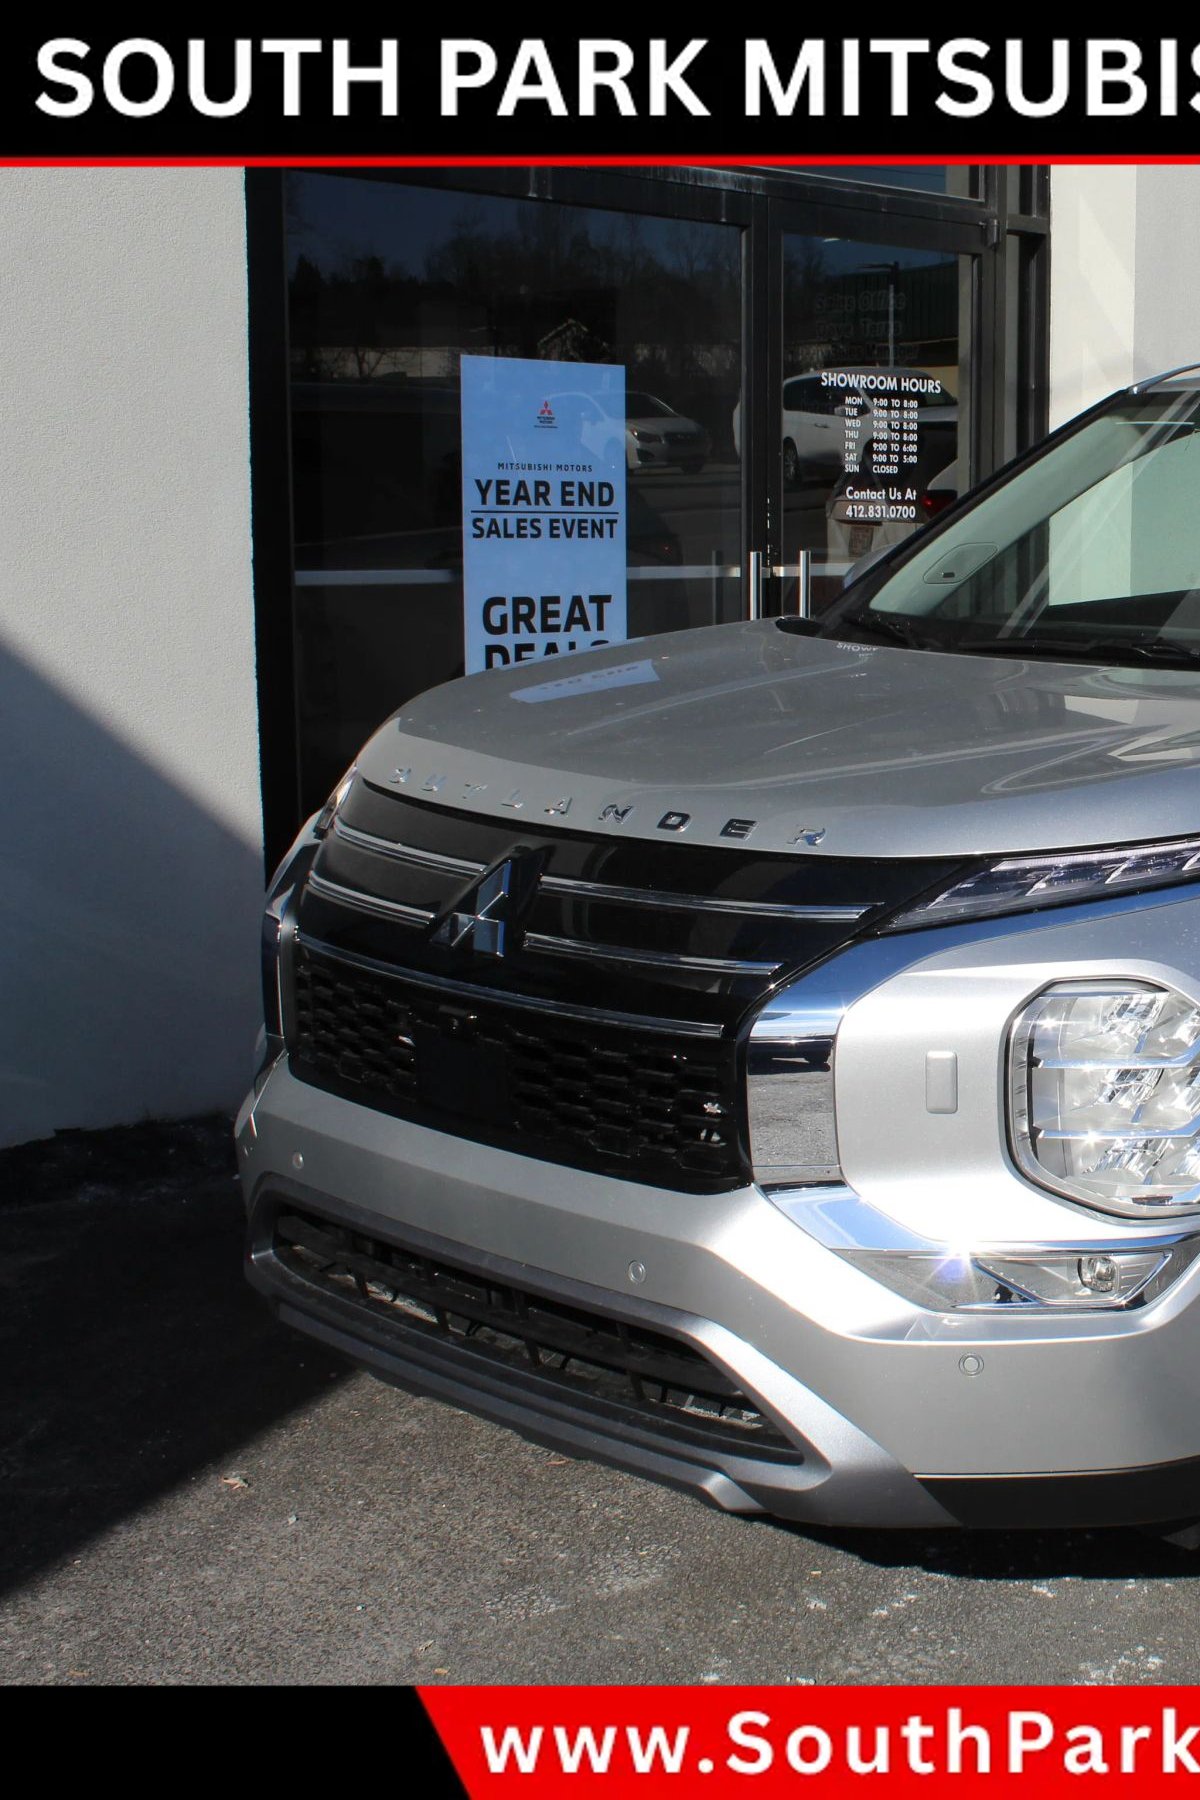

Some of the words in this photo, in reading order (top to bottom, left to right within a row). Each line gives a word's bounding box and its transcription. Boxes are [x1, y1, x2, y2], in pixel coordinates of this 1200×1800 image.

[821, 372, 898, 391] SHOWROOM
[900, 378, 941, 394] HOURS
[845, 396, 863, 406] MON
[873, 398, 888, 408] 9:00
[891, 399, 901, 408] TO
[903, 400, 919, 409] 8:00
[845, 408, 858, 417] TUE
[873, 409, 888, 418] 9:00
[891, 410, 901, 419] TO
[903, 411, 919, 419] 8:00
[845, 419, 861, 428] WED
[873, 420, 888, 429] 9:00
[891, 421, 901, 430] TO
[903, 422, 918, 431] 8:00
[845, 430, 859, 439] THU
[873, 431, 888, 440] 9:00
[891, 432, 901, 441] TO
[903, 433, 918, 442] 8:00
[845, 442, 856, 451] FRI
[873, 443, 888, 452] 9:00
[891, 444, 901, 452] TO
[902, 444, 918, 453] 6:00
[845, 453, 857, 462] SAT
[873, 454, 887, 463] 9:00
[890, 454, 899, 463] TO
[903, 455, 918, 464] 5:00
[497, 462, 552, 472] MITSUBISHI
[556, 464, 593, 473] MOTORS
[845, 464, 860, 473] SUN
[873, 465, 898, 474] CLOSED
[474, 479, 551, 506] YEAR
[560, 481, 615, 507] END
[846, 486, 886, 500] Contact
[889, 488, 902, 500] Us
[905, 488, 917, 501] At
[846, 505, 916, 518] 412.831.0700
[472, 517, 542, 539] SALES
[549, 518, 618, 539] EVENT
[482, 594, 612, 636] GREAT
